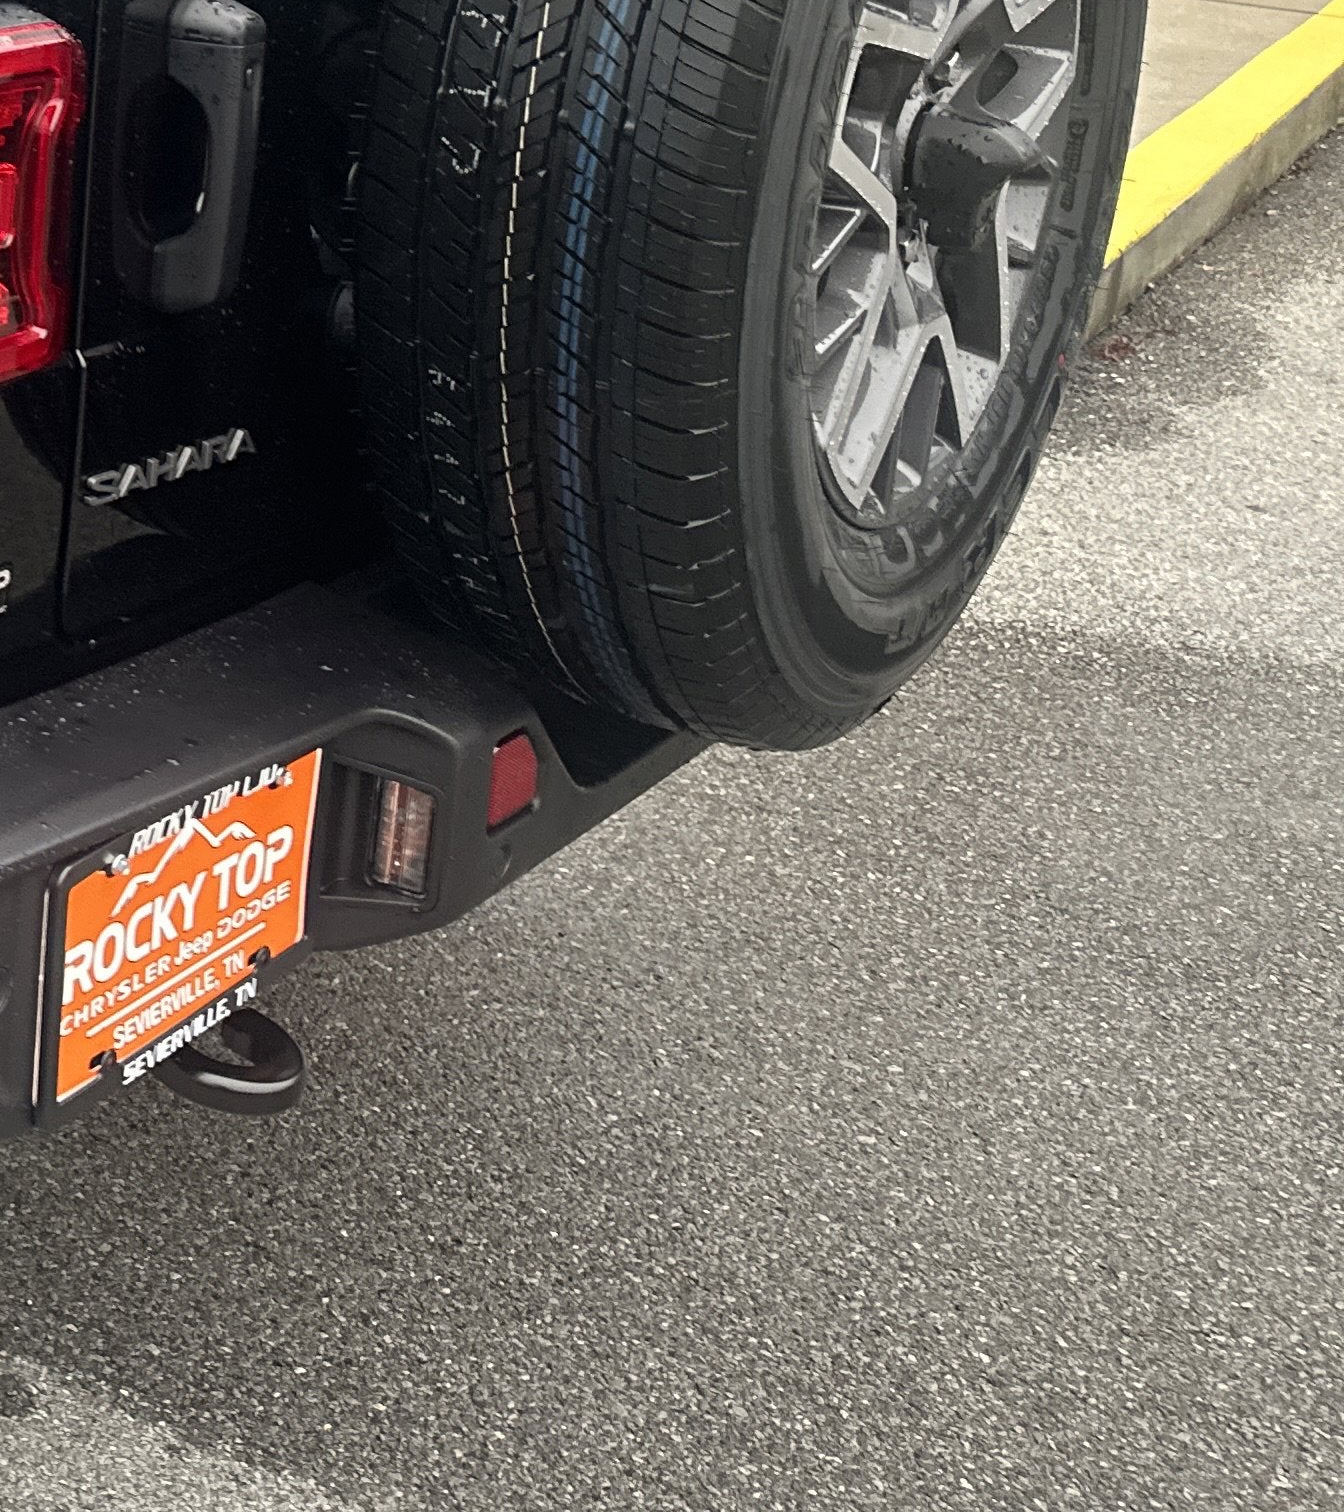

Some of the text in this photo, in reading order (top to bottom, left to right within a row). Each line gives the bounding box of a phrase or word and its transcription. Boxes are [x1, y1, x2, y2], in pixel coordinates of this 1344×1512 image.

[83, 427, 256, 506] SAHARA
[62, 824, 294, 1005] ROCKY TOP
[59, 879, 292, 1037] CHRYSLER Jeep DODGE
[223, 949, 245, 978] TN
[234, 977, 258, 1007] TN
